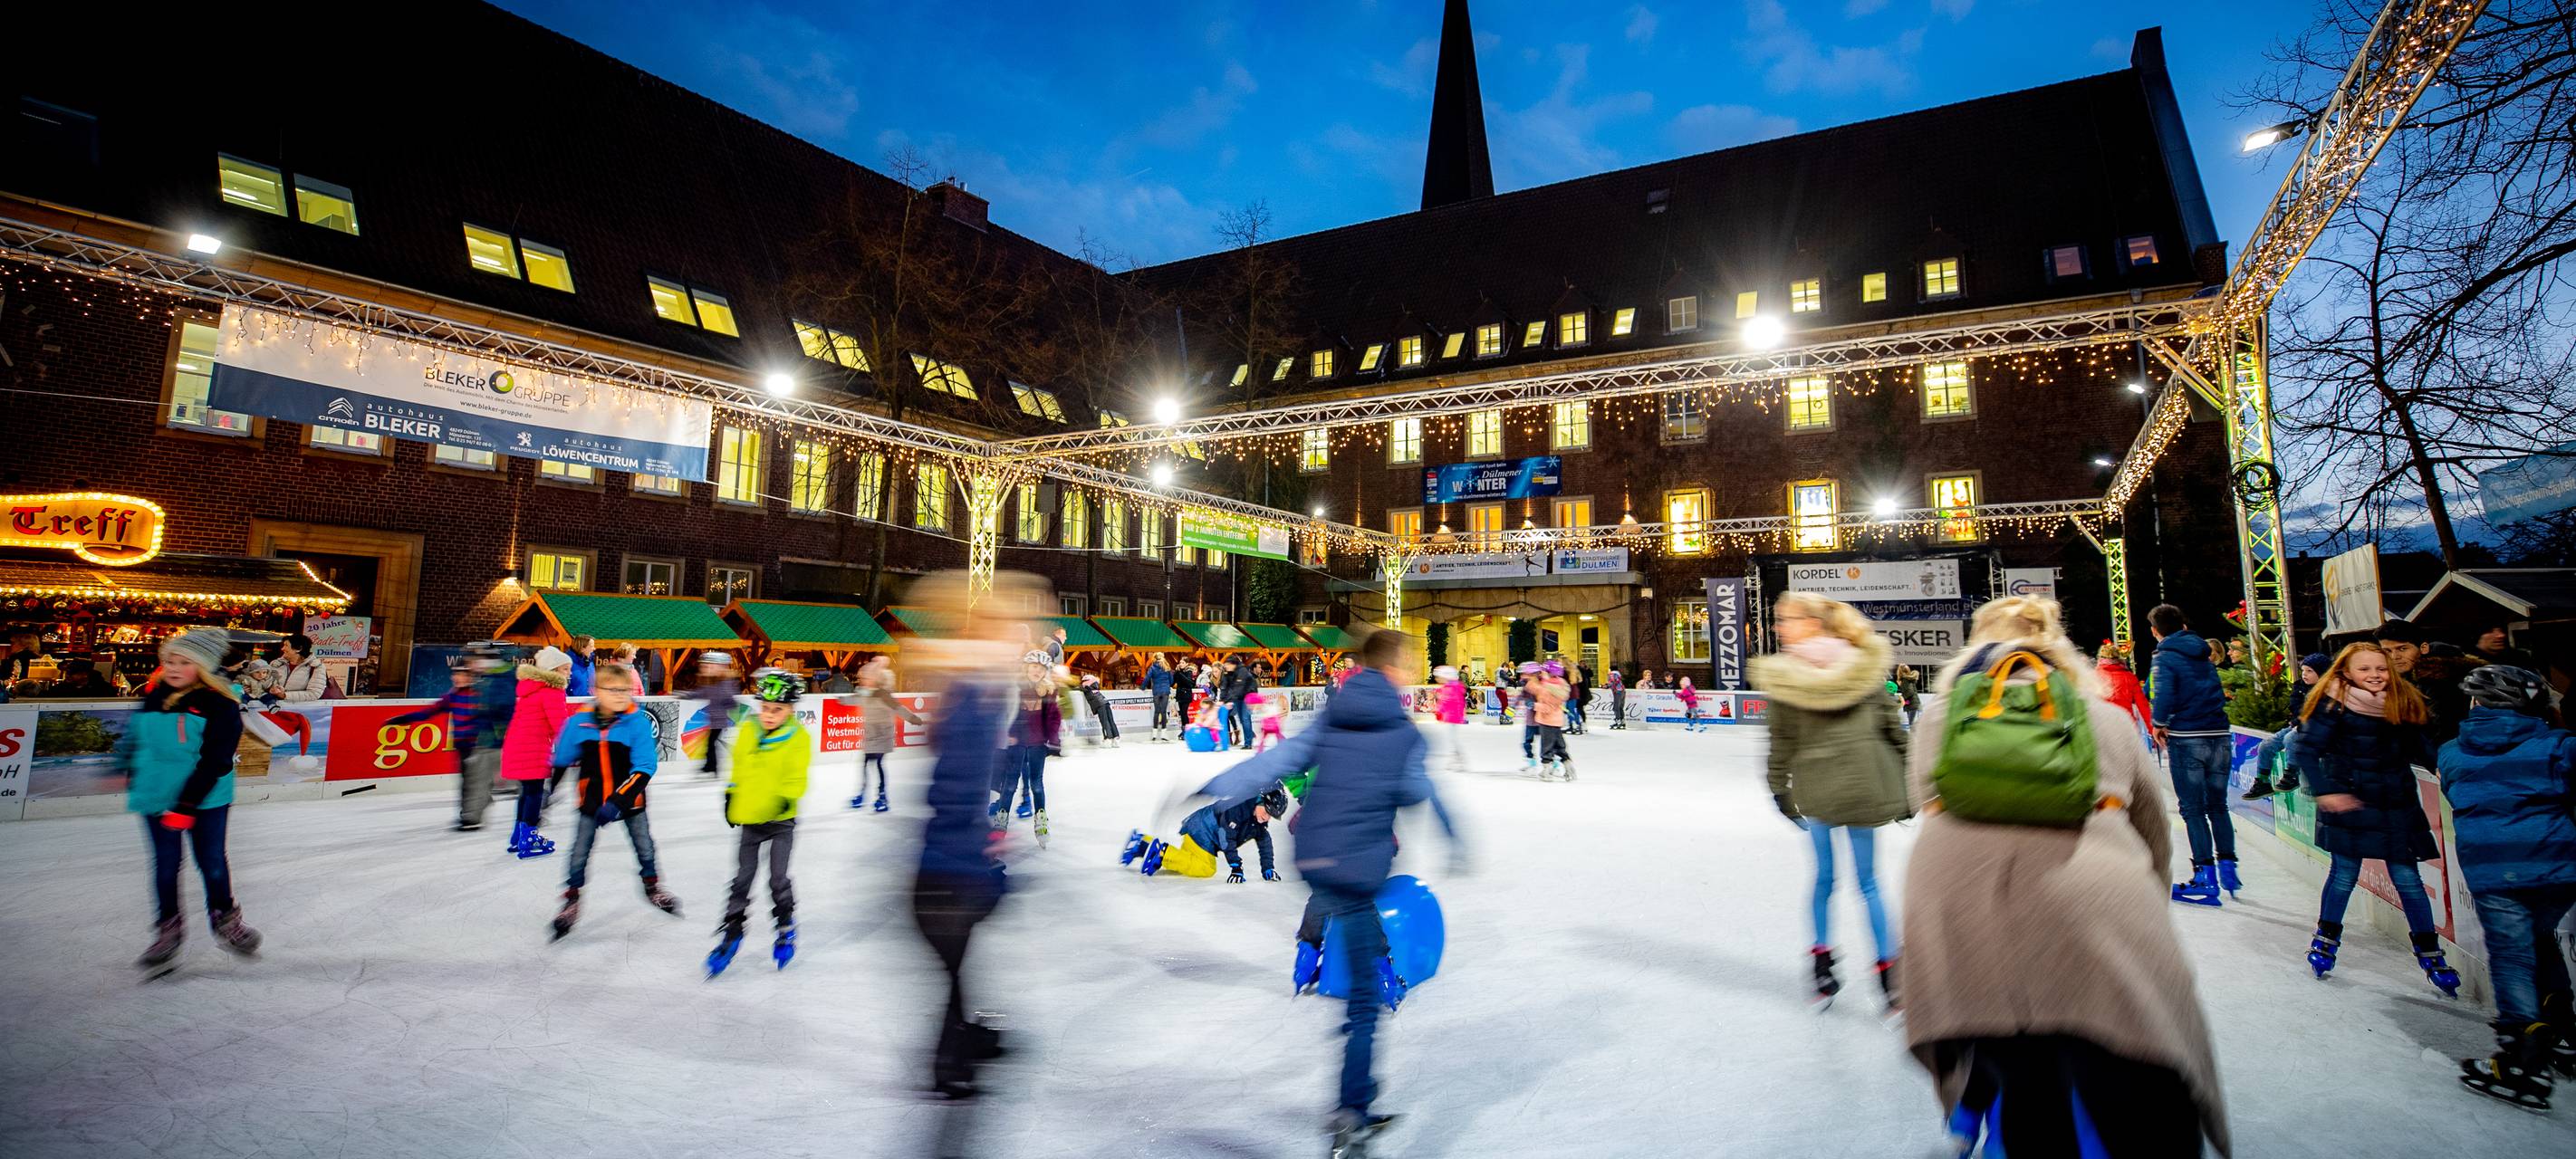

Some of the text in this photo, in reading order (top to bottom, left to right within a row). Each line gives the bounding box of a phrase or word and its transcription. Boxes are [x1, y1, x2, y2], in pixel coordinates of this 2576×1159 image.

[425, 367, 572, 407] BLEKER GRUPPE
[367, 402, 444, 422] autohaus
[459, 399, 533, 419] www.bleker-gruppe.de
[318, 415, 360, 426] CITROËN
[364, 413, 441, 439] BLEKER
[510, 445, 541, 455] PEUGEOT
[564, 436, 622, 451] autohaus
[543, 445, 639, 469] LÖWENCENTRUM
[1482, 469, 1523, 479] Dülmener
[8, 505, 137, 542] Treff
[1581, 560, 1618, 569] DÜLMEN
[1793, 569, 1841, 580] KORDEL
[1862, 600, 1960, 615] Westmünsterland
[306, 618, 348, 632] 20 Jahre
[1716, 582, 1741, 692] MEZZOMAR
[316, 648, 352, 656] Dülmen
[826, 741, 841, 751] Gut
[841, 740, 854, 750] für
